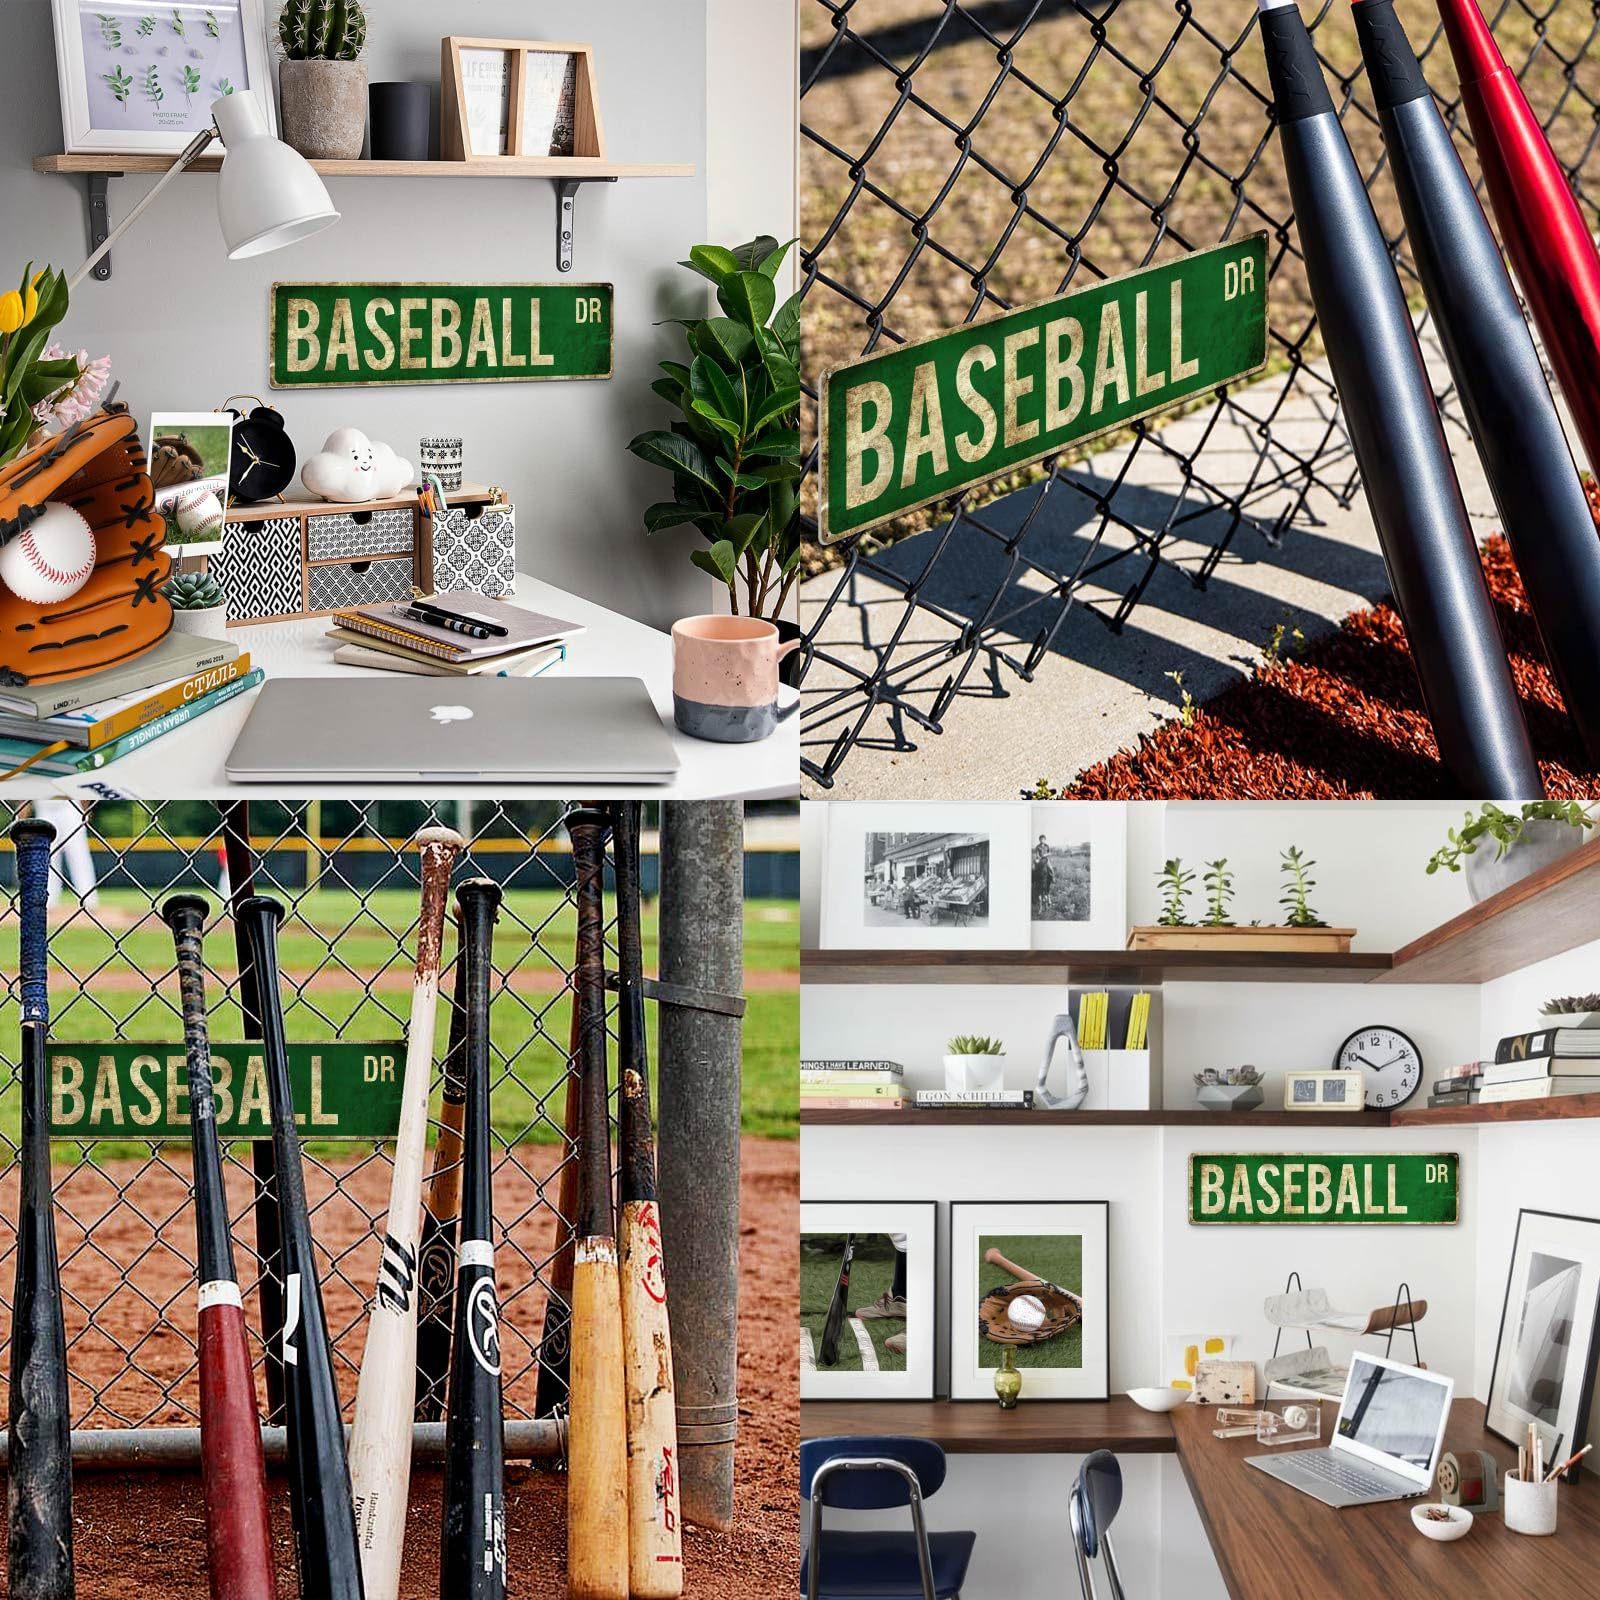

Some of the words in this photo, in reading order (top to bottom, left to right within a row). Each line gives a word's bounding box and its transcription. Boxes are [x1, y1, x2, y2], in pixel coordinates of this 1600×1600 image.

[286, 297, 555, 372] BASEBALL
[575, 297, 602, 325] DR
[845, 278, 1200, 511] BASEBALL
[1223, 255, 1256, 302] DR
[196, 656, 213, 668] SPRING
[183, 662, 237, 700] СТИЛЬ
[163, 709, 190, 729] URBAN
[128, 723, 162, 748] JUNGLE
[1358, 1041, 1364, 1050] 11
[1370, 1037, 1380, 1046] 12
[1348, 1052, 1358, 1062] 10
[847, 1062, 890, 1070] LEARNED
[1404, 1064, 1411, 1073] 3
[1401, 1079, 1408, 1088] 4
[51, 1054, 339, 1125] BASEBAL
[363, 1055, 396, 1082] DR
[1391, 1090, 1398, 1099] 5
[918, 1091, 951, 1101] EGON
[1376, 1094, 1384, 1103] 6
[1200, 1163, 1408, 1215] BASEBALL
[1425, 1163, 1448, 1184] DR
